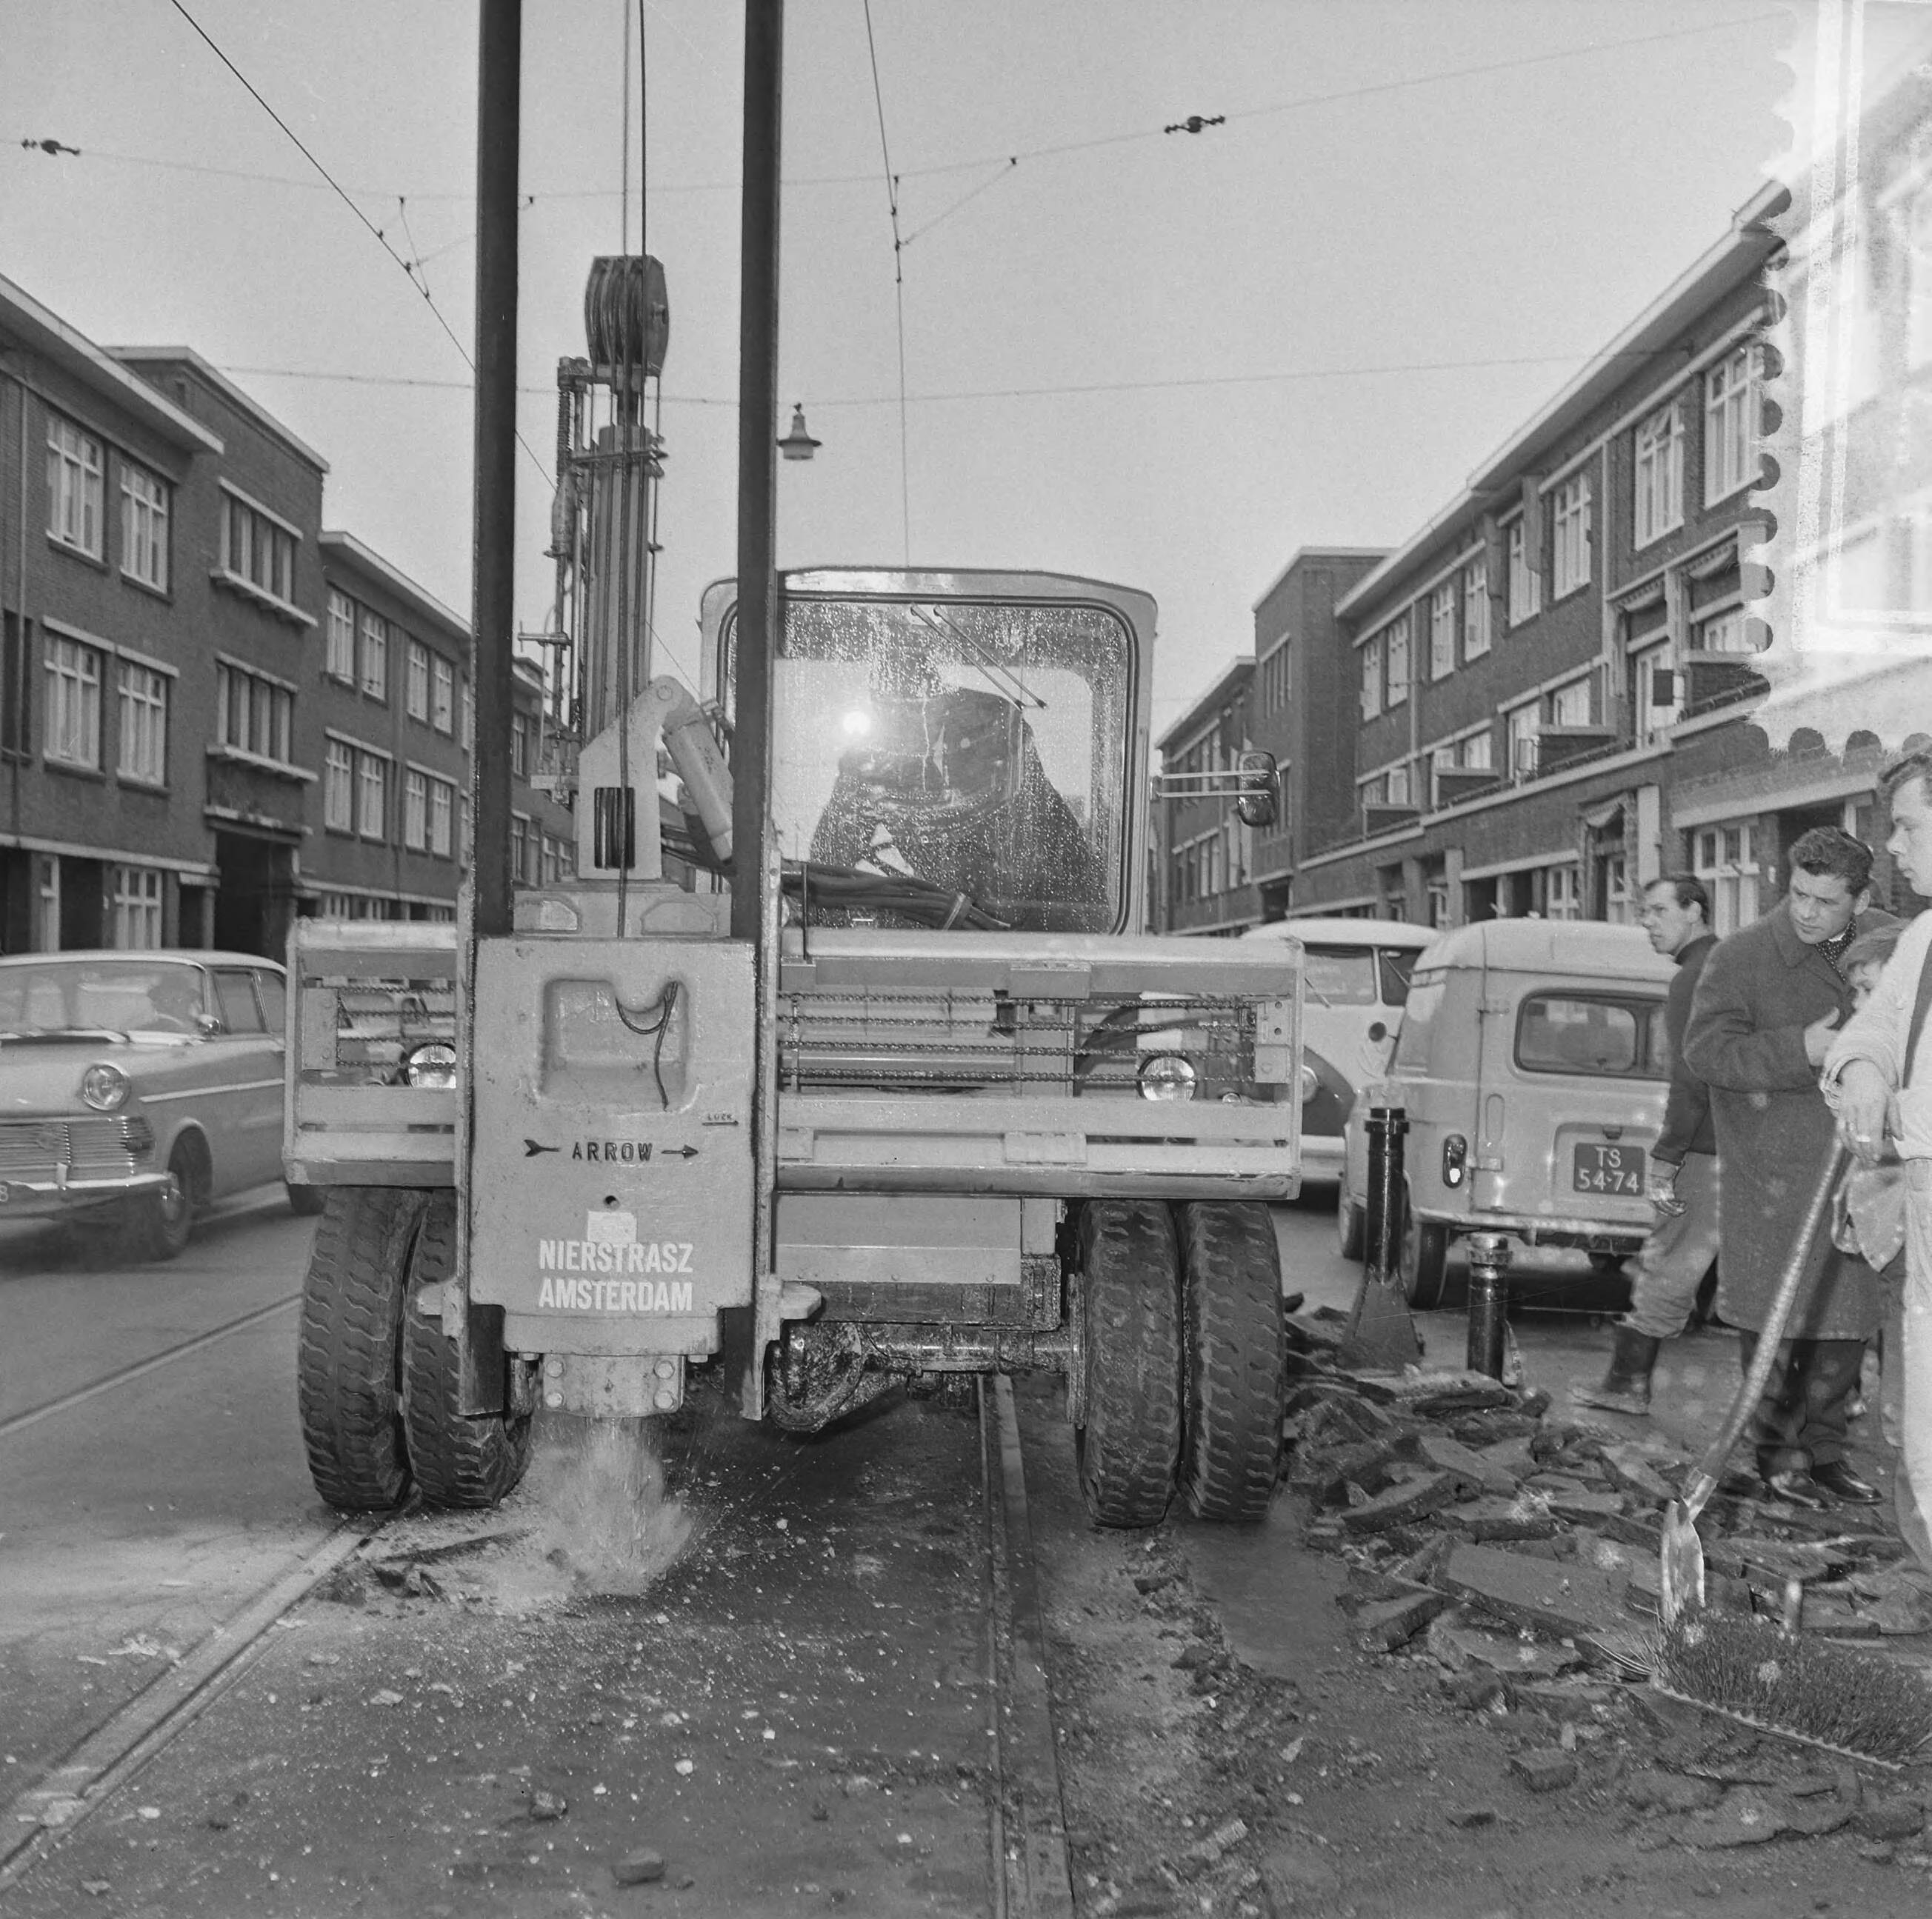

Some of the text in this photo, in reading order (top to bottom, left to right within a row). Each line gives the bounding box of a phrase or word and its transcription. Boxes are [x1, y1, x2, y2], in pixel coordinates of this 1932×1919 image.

[572, 1141, 653, 1161] ARROW
[1594, 1146, 1621, 1168] TS
[539, 1239, 693, 1272] NIERSTRASZ
[539, 1277, 693, 1311] AMSTERDAM
